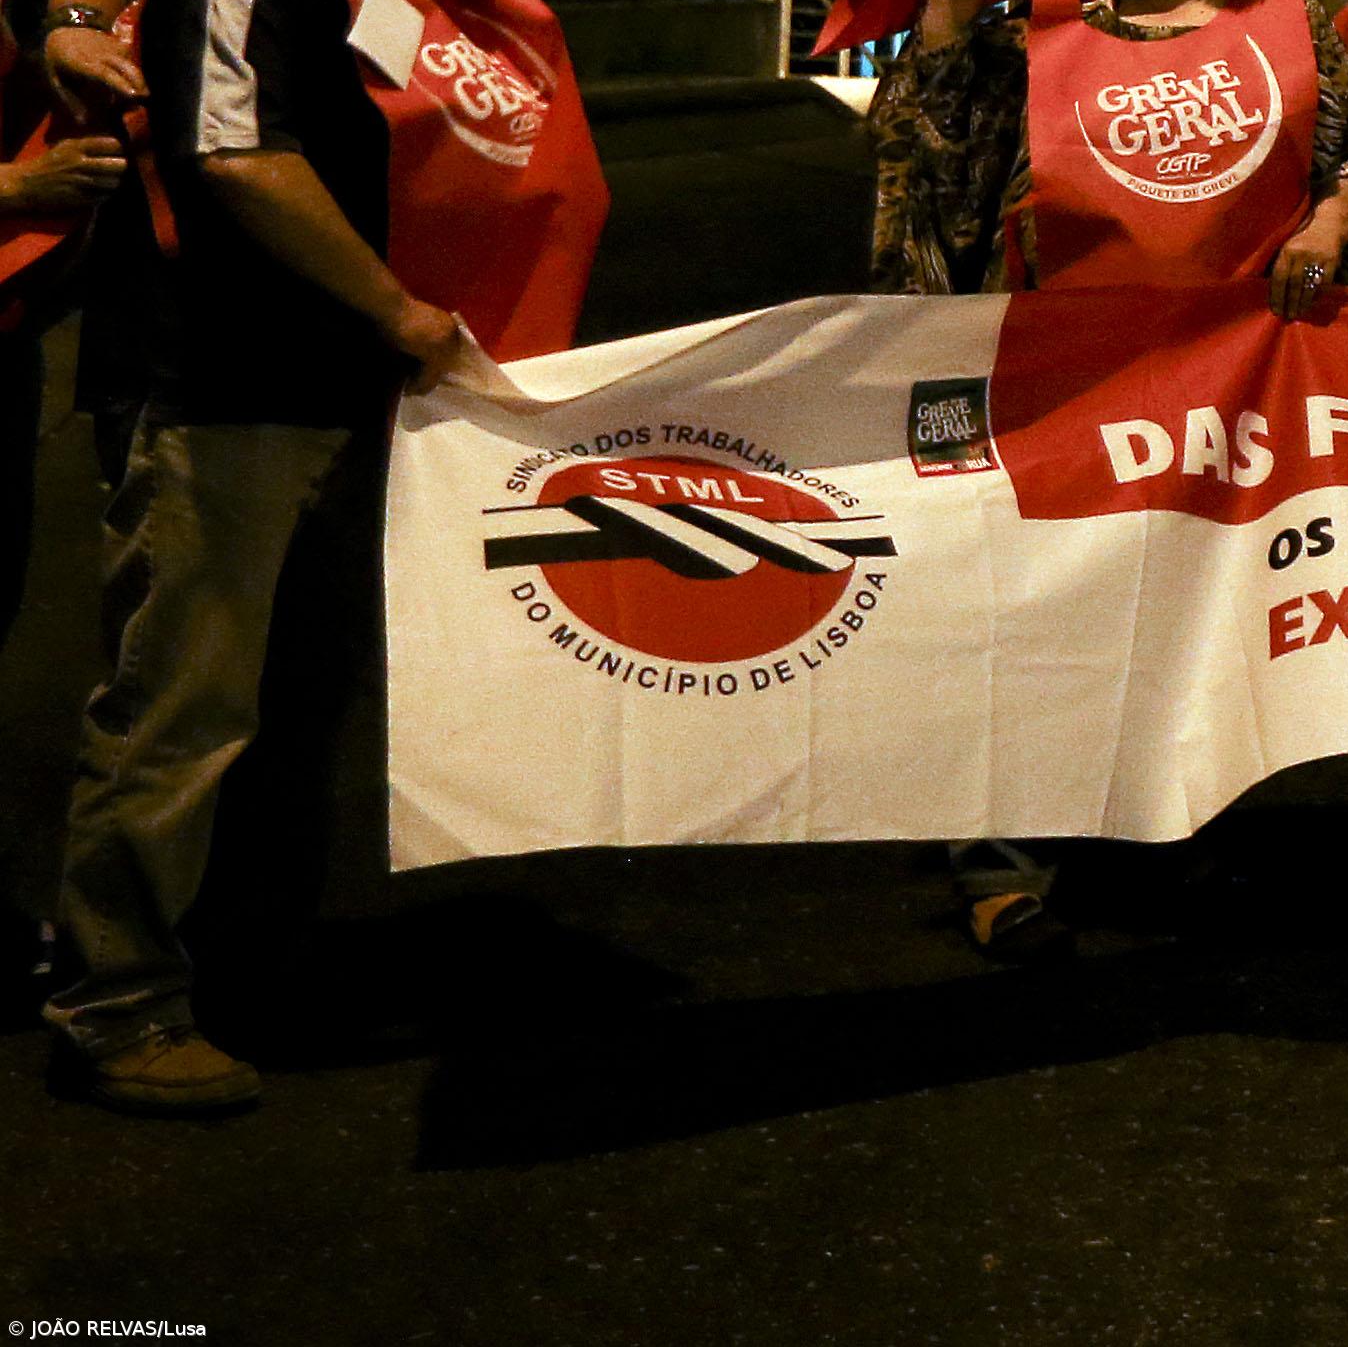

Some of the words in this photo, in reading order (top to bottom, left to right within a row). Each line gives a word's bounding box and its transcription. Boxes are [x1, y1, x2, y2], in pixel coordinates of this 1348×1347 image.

[1096, 60, 1241, 115] GREVE
[1108, 90, 1264, 156] GERAL
[1128, 178, 1179, 199] PIQUETE
[1183, 189, 1200, 199] DE
[1202, 174, 1239, 195] GREVE
[1156, 153, 1212, 174] CGTP
[917, 397, 972, 425] GREVE
[917, 414, 978, 443] GERAL
[595, 427, 652, 455] DOS
[660, 424, 861, 510] TRABALHADORES
[1099, 405, 1276, 489] DAS
[599, 467, 765, 504] STML
[1267, 516, 1337, 571] OS
[510, 581, 552, 623] DO
[548, 623, 739, 697] MUNICÍPIO
[749, 659, 795, 692] DE
[798, 570, 889, 671] LISBOA
